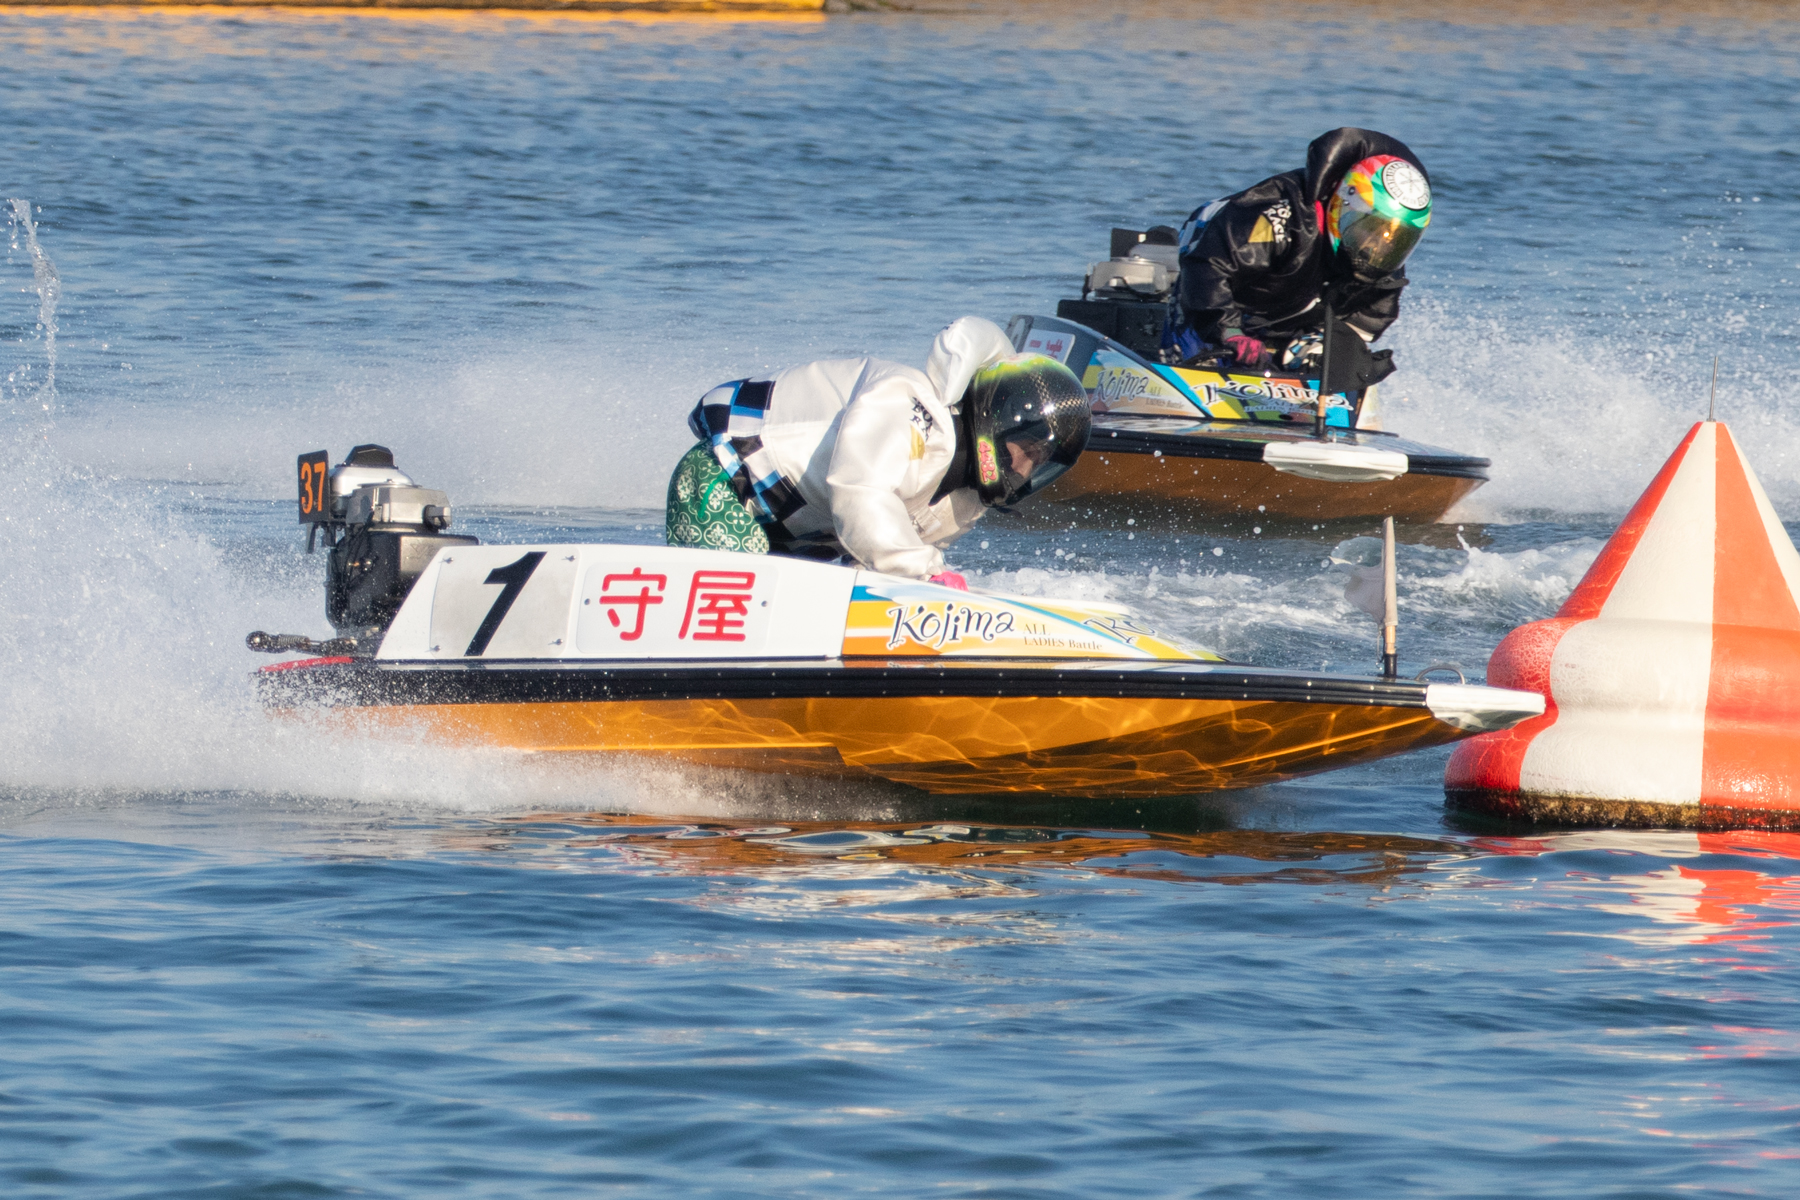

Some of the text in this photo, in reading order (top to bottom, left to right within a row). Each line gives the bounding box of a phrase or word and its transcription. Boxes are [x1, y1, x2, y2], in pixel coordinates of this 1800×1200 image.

[1092, 369, 1149, 403] Kojima
[978, 440, 997, 484] 4482
[300, 461, 326, 515] 37
[463, 550, 548, 657] 1
[599, 566, 756, 642] 守屋
[886, 602, 1014, 649] Kojima
[1022, 623, 1051, 636] ALL
[1023, 636, 1103, 650] LADIES Battle
